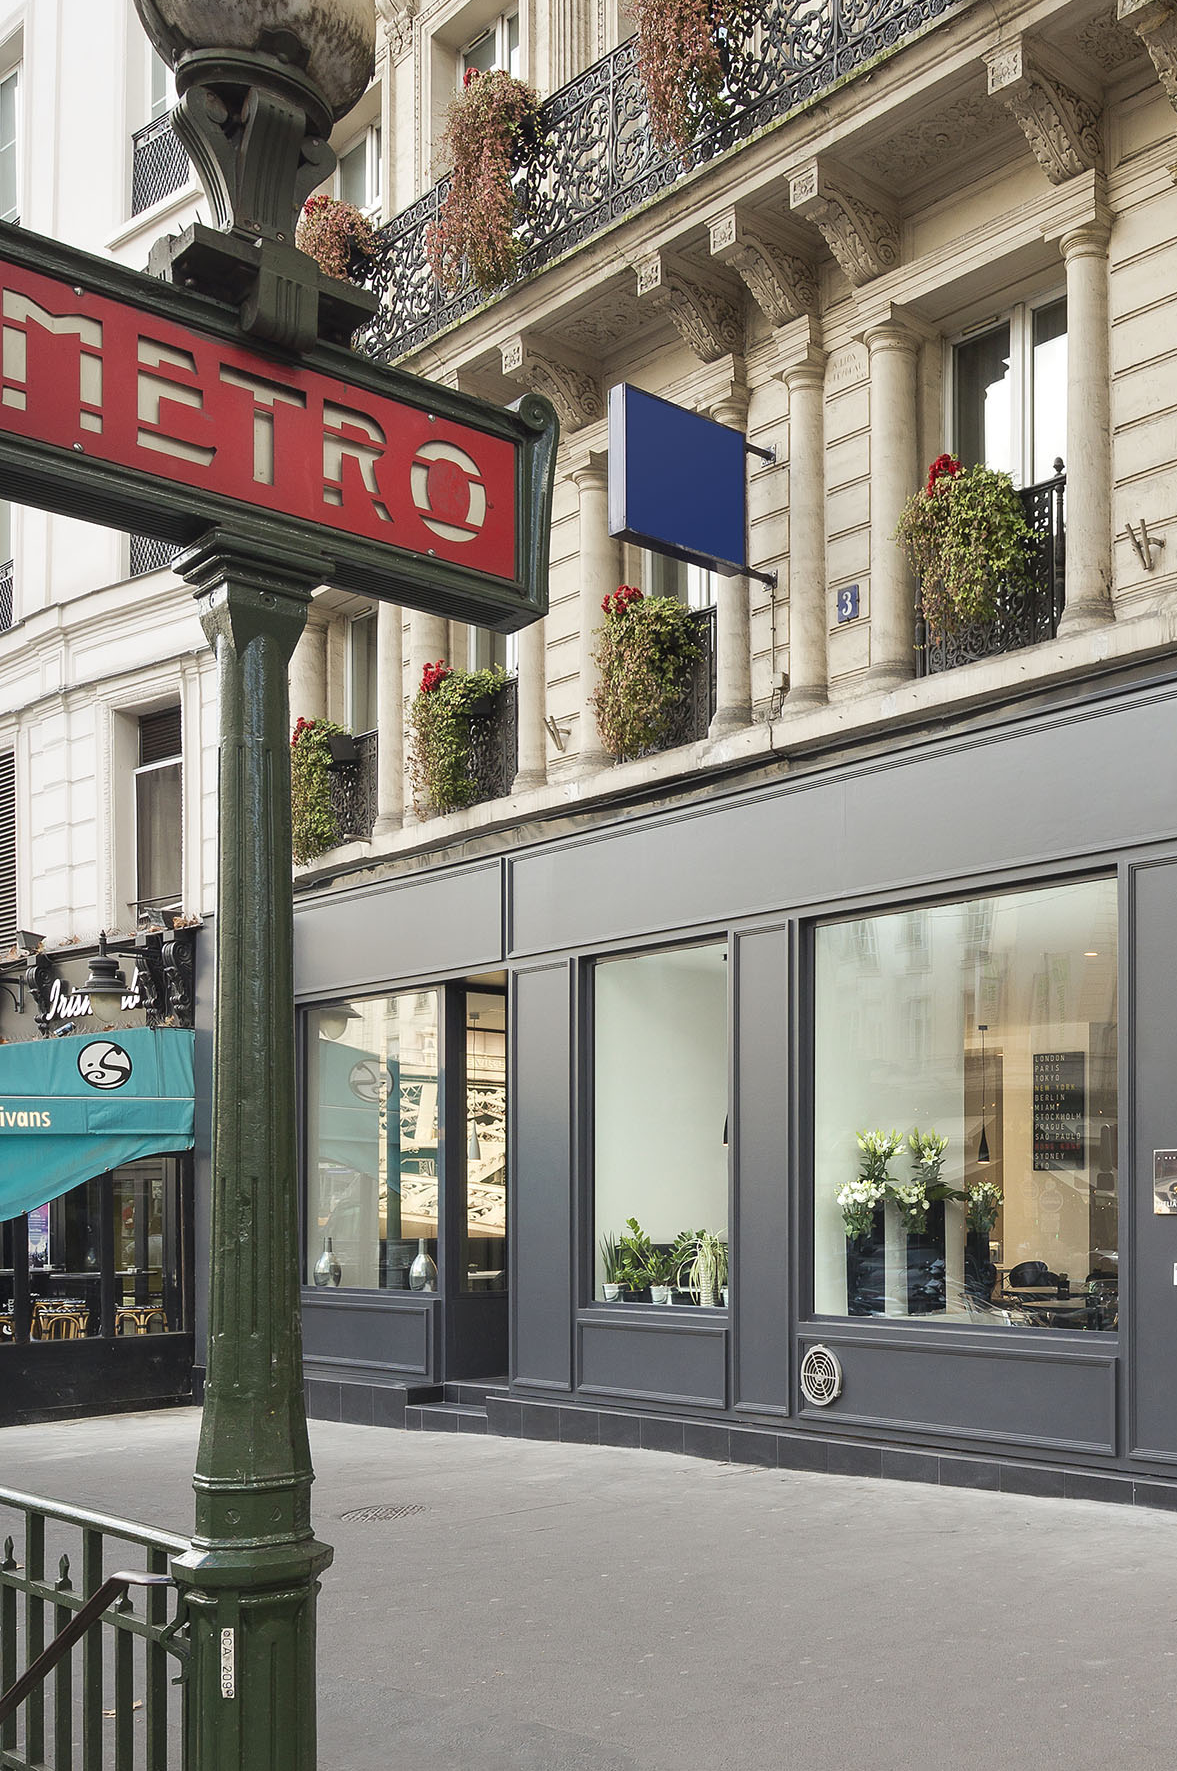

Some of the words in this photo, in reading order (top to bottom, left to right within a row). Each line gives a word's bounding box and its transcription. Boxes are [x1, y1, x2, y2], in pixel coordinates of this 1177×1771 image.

[2, 289, 487, 543] METRO
[842, 591, 852, 616] 3
[1035, 1054, 1065, 1062] LONDON
[1035, 1064, 1060, 1073] PARIS
[1035, 1074, 1060, 1082] TOKYO
[1055, 1083, 1076, 1091] YORK
[0, 1106, 51, 1127] ivans
[1035, 1113, 1081, 1121] STOCKHOLM
[1055, 1132, 1081, 1140] PAULO
[1035, 1162, 1050, 1170] RIO
[222, 1638, 233, 1656] CA
[222, 1666, 233, 1689] 209
